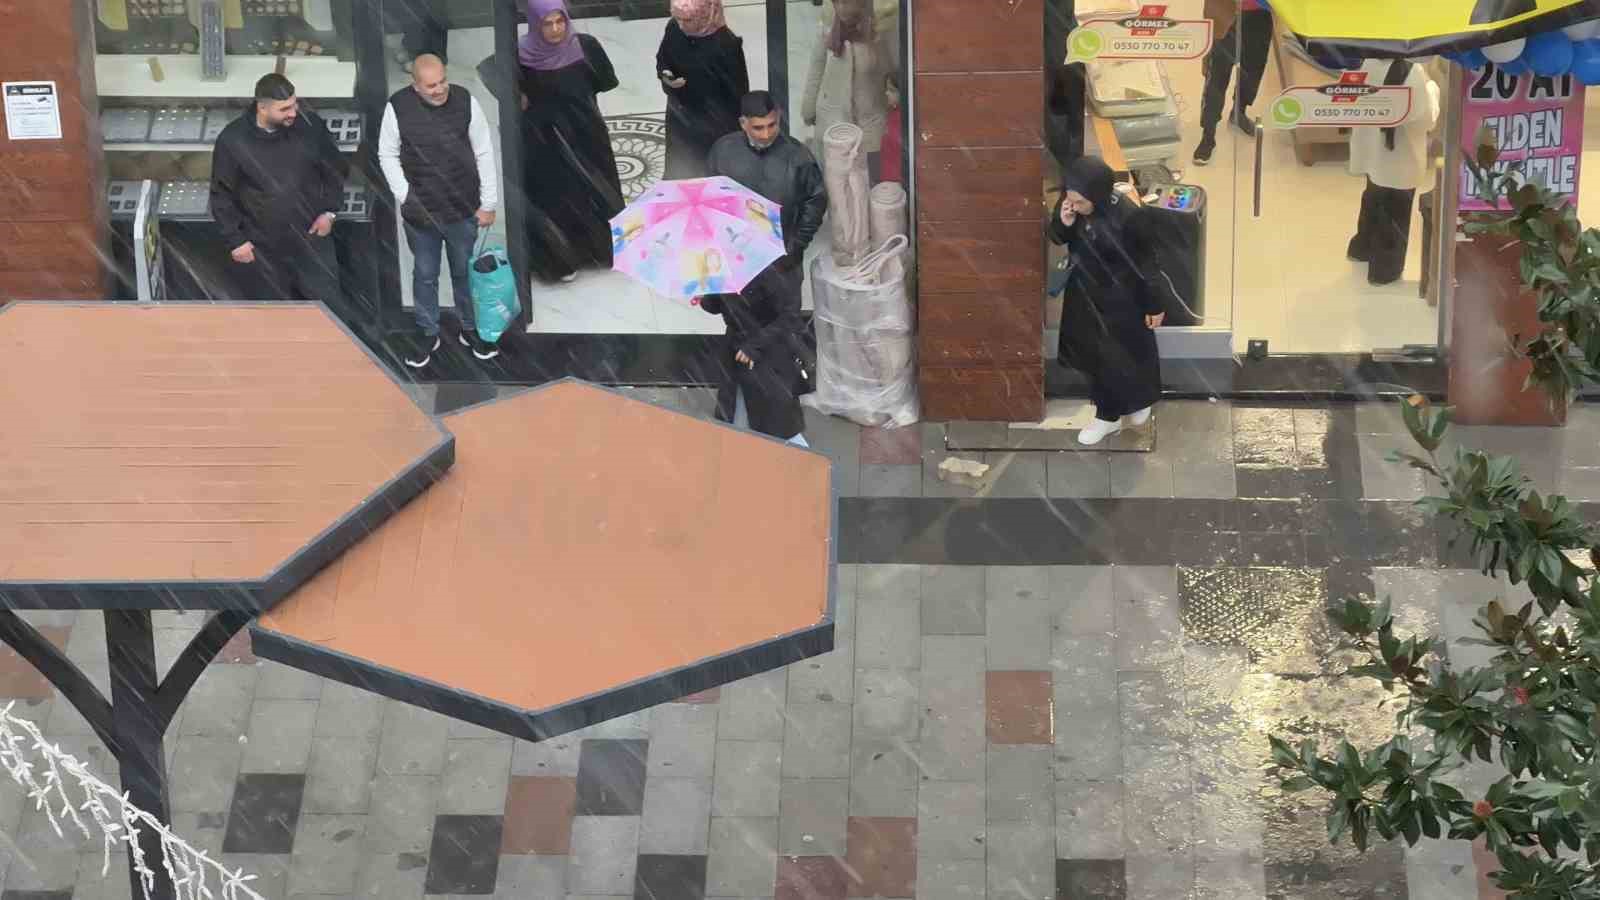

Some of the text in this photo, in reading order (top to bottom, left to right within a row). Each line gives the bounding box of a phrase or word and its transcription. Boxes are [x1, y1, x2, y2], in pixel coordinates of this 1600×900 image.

[1142, 42, 1160, 50] 770
[1163, 42, 1175, 50] 70
[1343, 109, 1360, 117] 770
[1363, 109, 1376, 117] 70
